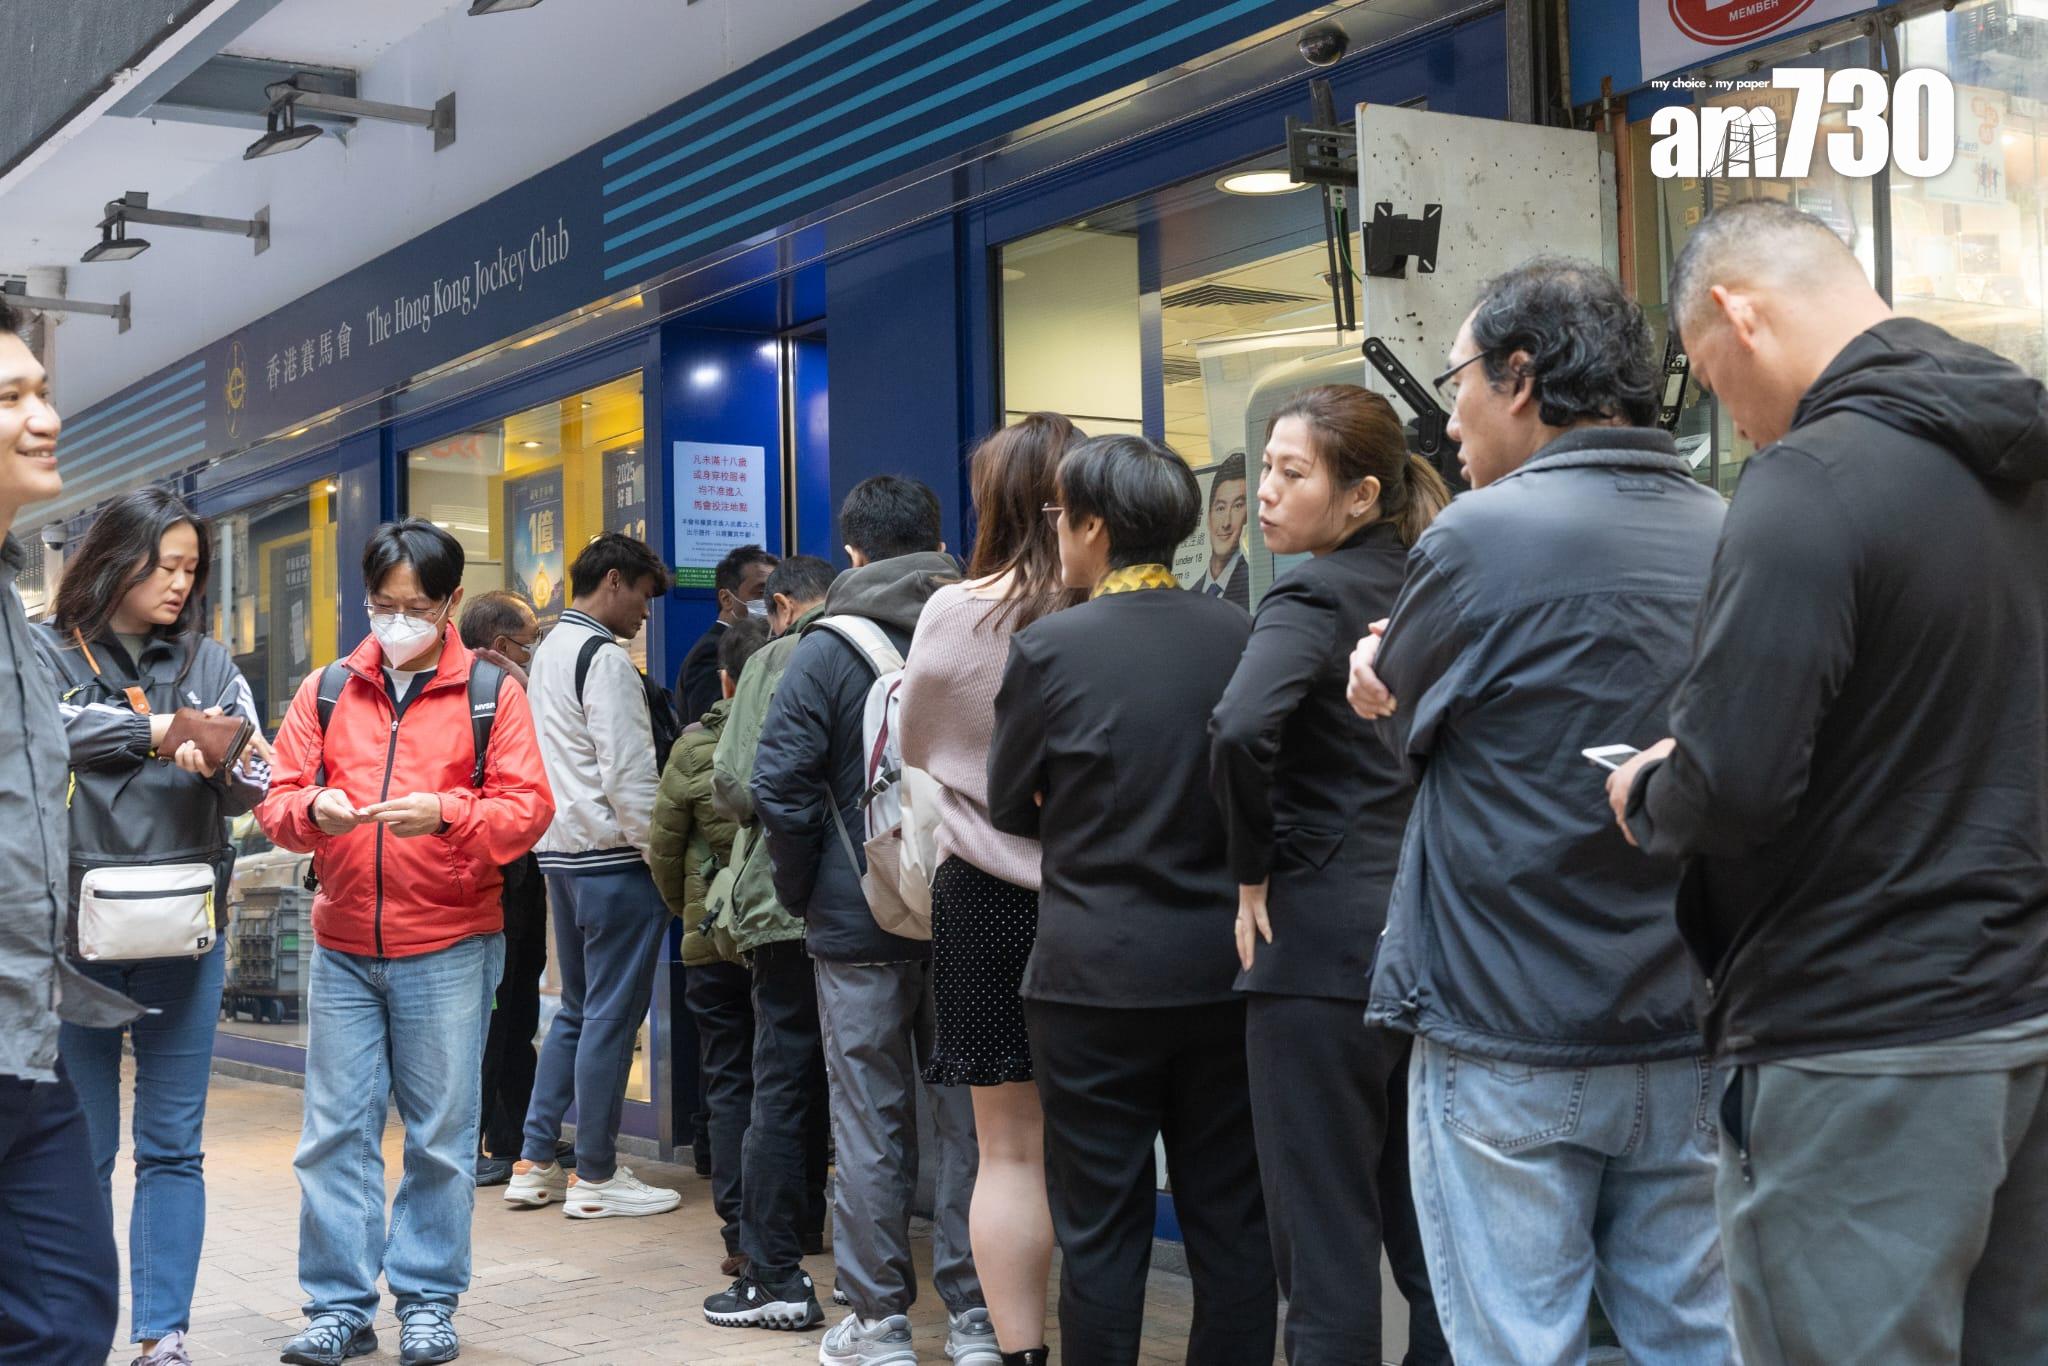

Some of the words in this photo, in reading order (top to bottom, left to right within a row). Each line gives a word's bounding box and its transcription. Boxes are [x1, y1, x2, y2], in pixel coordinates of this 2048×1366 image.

[1729, 0, 1779, 23] MEMBER
[366, 304, 391, 346] The
[394, 294, 431, 334] Hong
[433, 275, 471, 316] Kong
[472, 246, 527, 310] Jockey
[530, 217, 569, 272] Club
[266, 321, 352, 391] 香港賽馬會
[616, 461, 635, 485] 2025
[1175, 555, 1194, 566] under
[1195, 552, 1203, 563] 18
